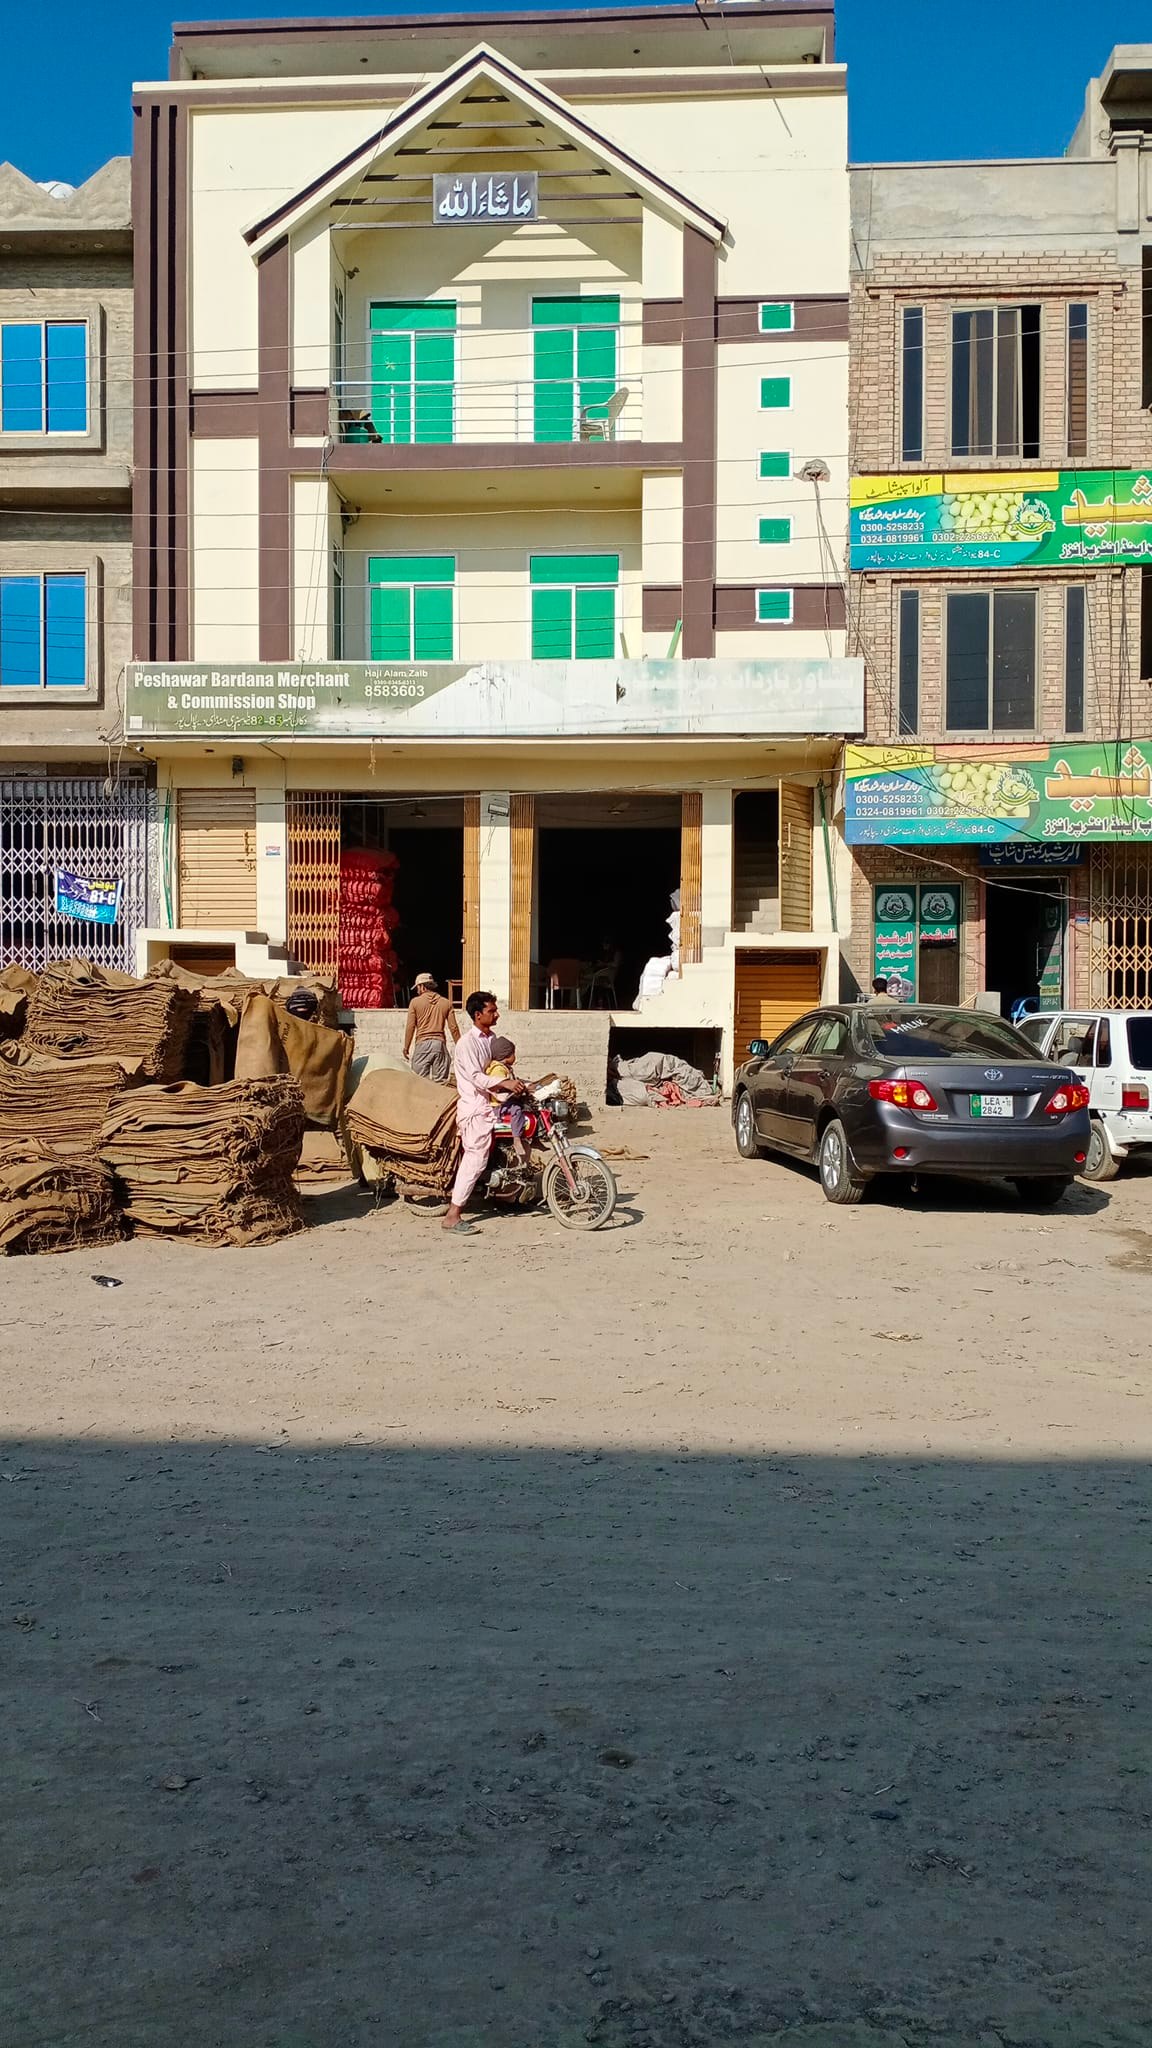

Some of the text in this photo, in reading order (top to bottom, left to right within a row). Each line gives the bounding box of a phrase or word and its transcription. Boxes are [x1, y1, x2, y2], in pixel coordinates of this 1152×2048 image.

[860, 522, 925, 532] 0300-5258233
[860, 532, 1000, 543] 0324-0819961 0302-2256421
[978, 549, 1000, 559] 84-C
[365, 669, 382, 678] Haji
[409, 669, 428, 677] Zaib
[134, 671, 350, 688] Peshawar Bardana Merchant
[365, 685, 425, 696] 8583603
[167, 693, 316, 711] & Commission Shop
[855, 794, 924, 804] 0300-5258233
[855, 807, 923, 817] 0324-0819961
[972, 825, 995, 835] 84-C
[89, 890, 116, 905] 81-C
[890, 1019, 928, 1034] MALIK
[984, 1096, 1000, 1106] LEA
[982, 1106, 1003, 1115] 2842
